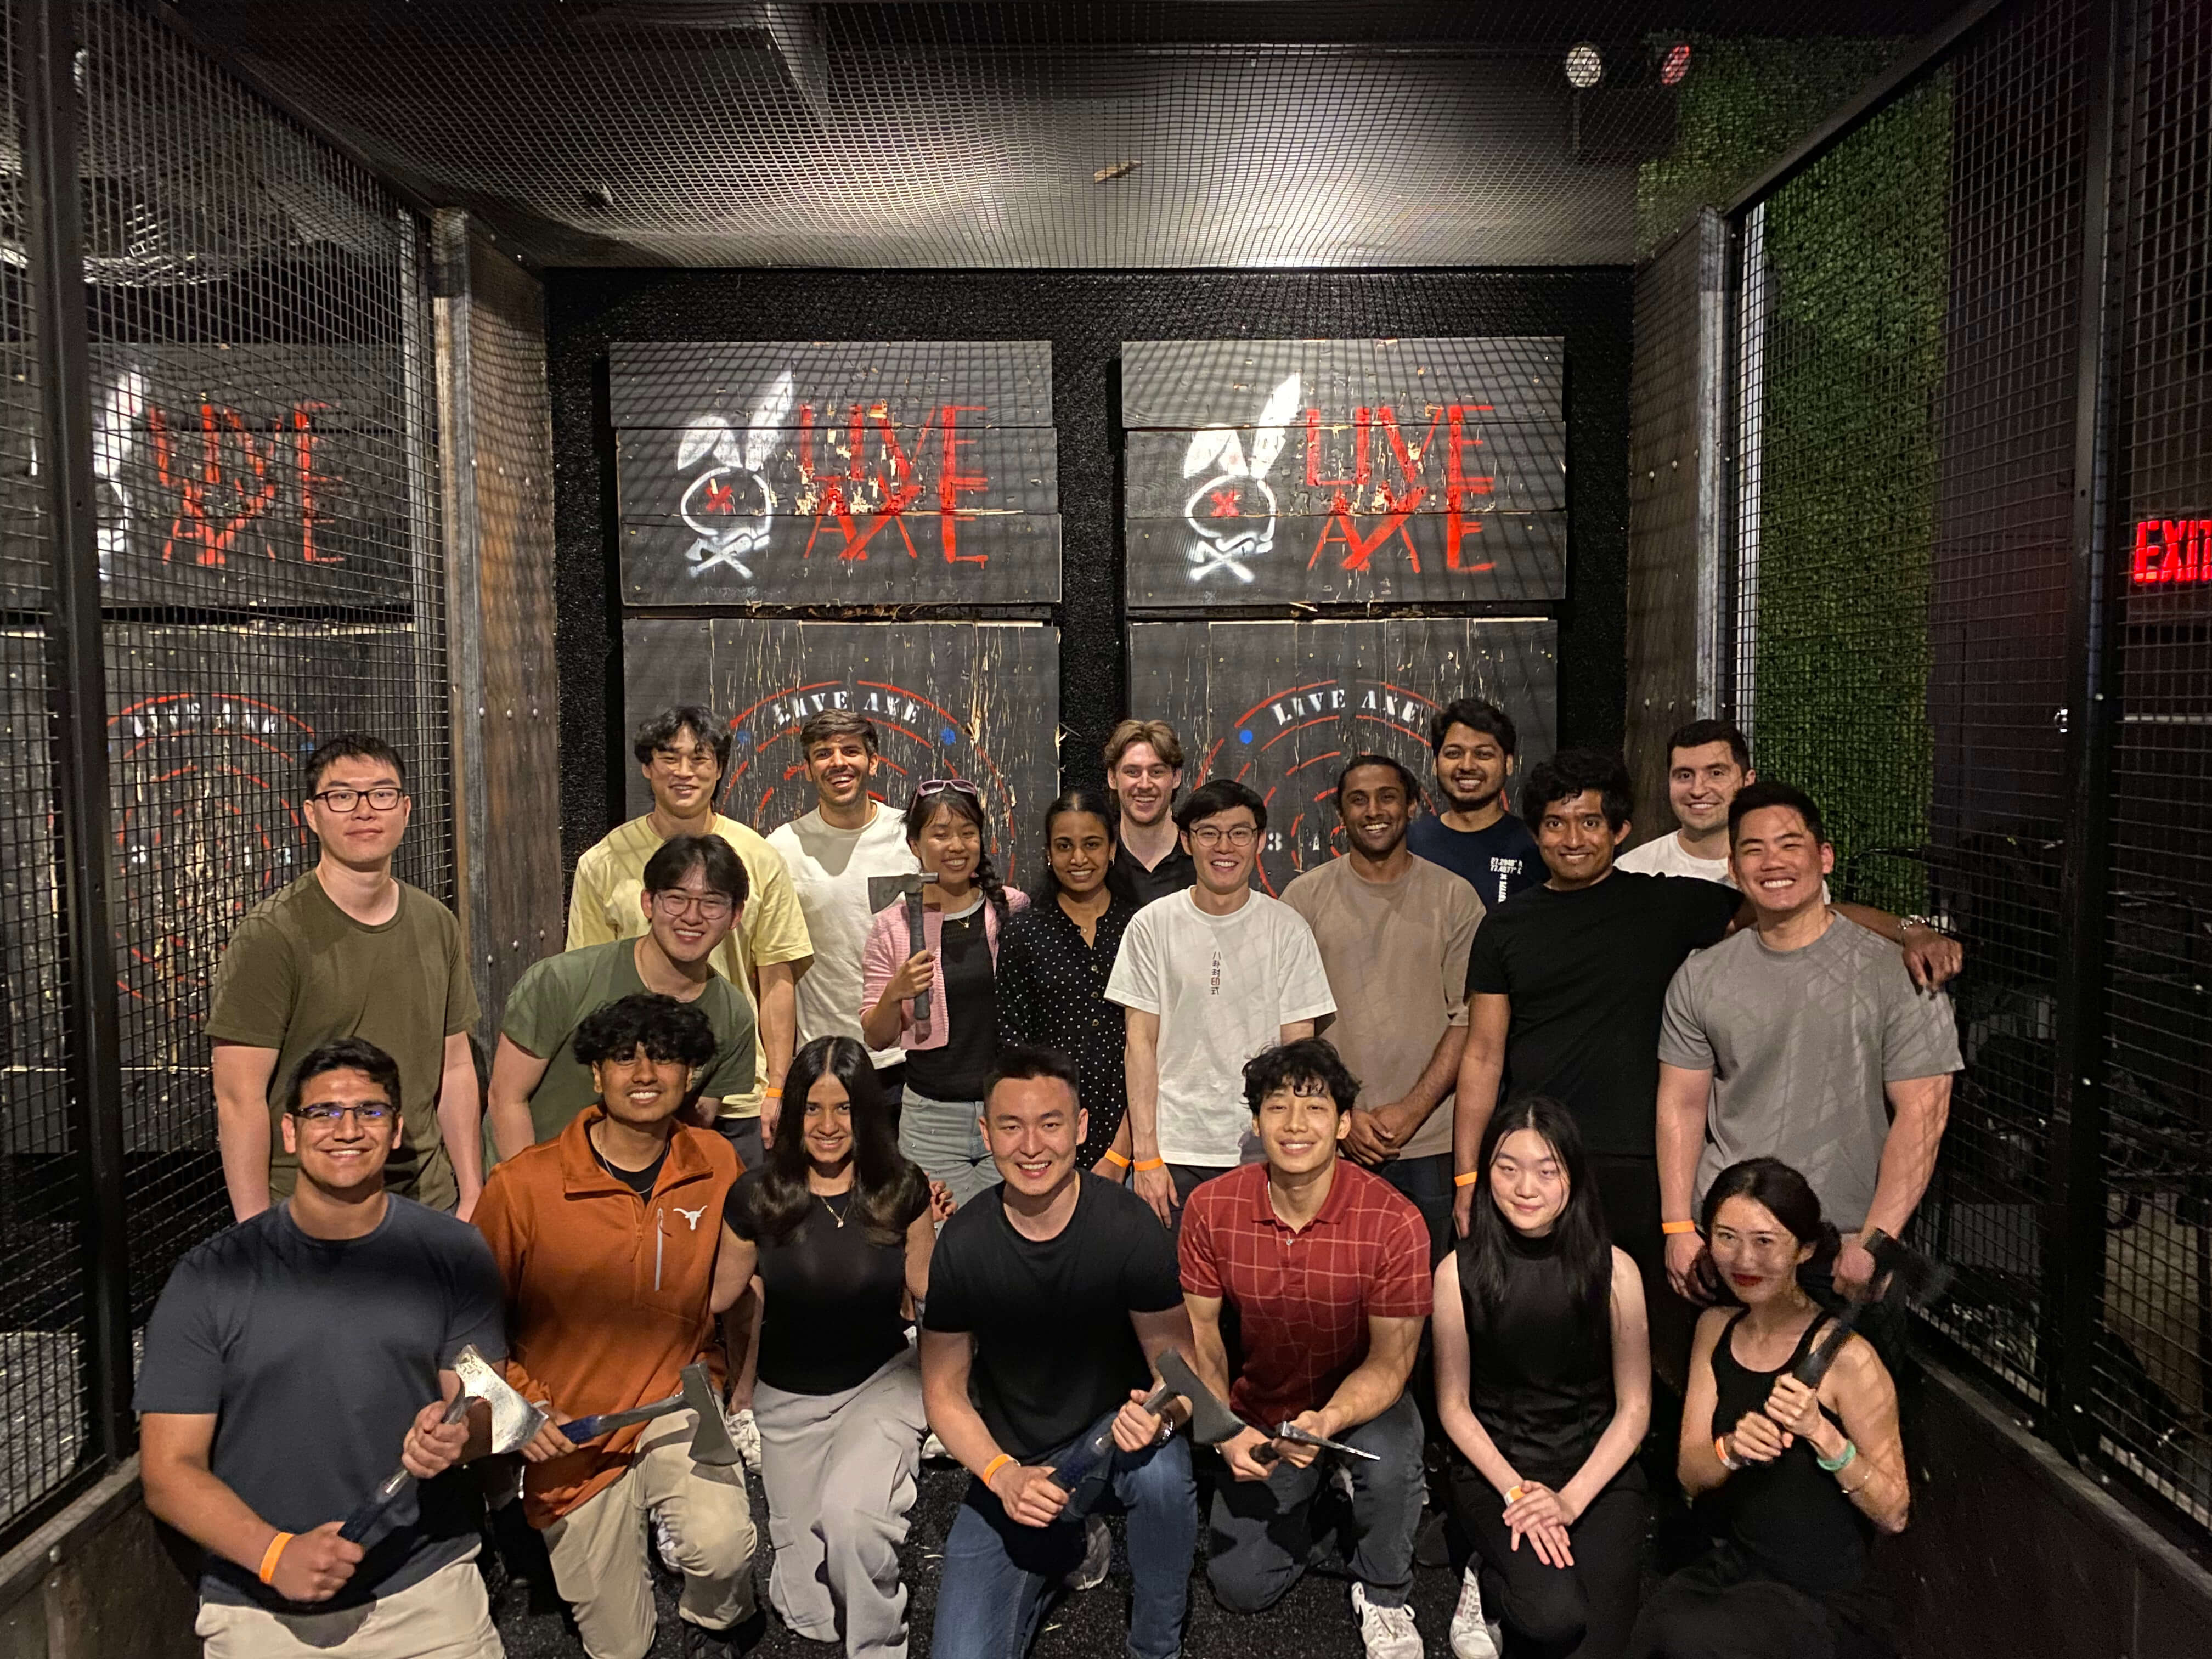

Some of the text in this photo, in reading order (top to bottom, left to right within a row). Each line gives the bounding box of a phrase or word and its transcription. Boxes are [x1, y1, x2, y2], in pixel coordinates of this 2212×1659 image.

[799, 403, 988, 484] LIVE
[1306, 405, 1494, 485] LIVE
[803, 476, 988, 569] AXE
[1307, 482, 1497, 574] AXE
[771, 690, 848, 726] LIVE
[1272, 689, 1420, 726] LIVE AXE
